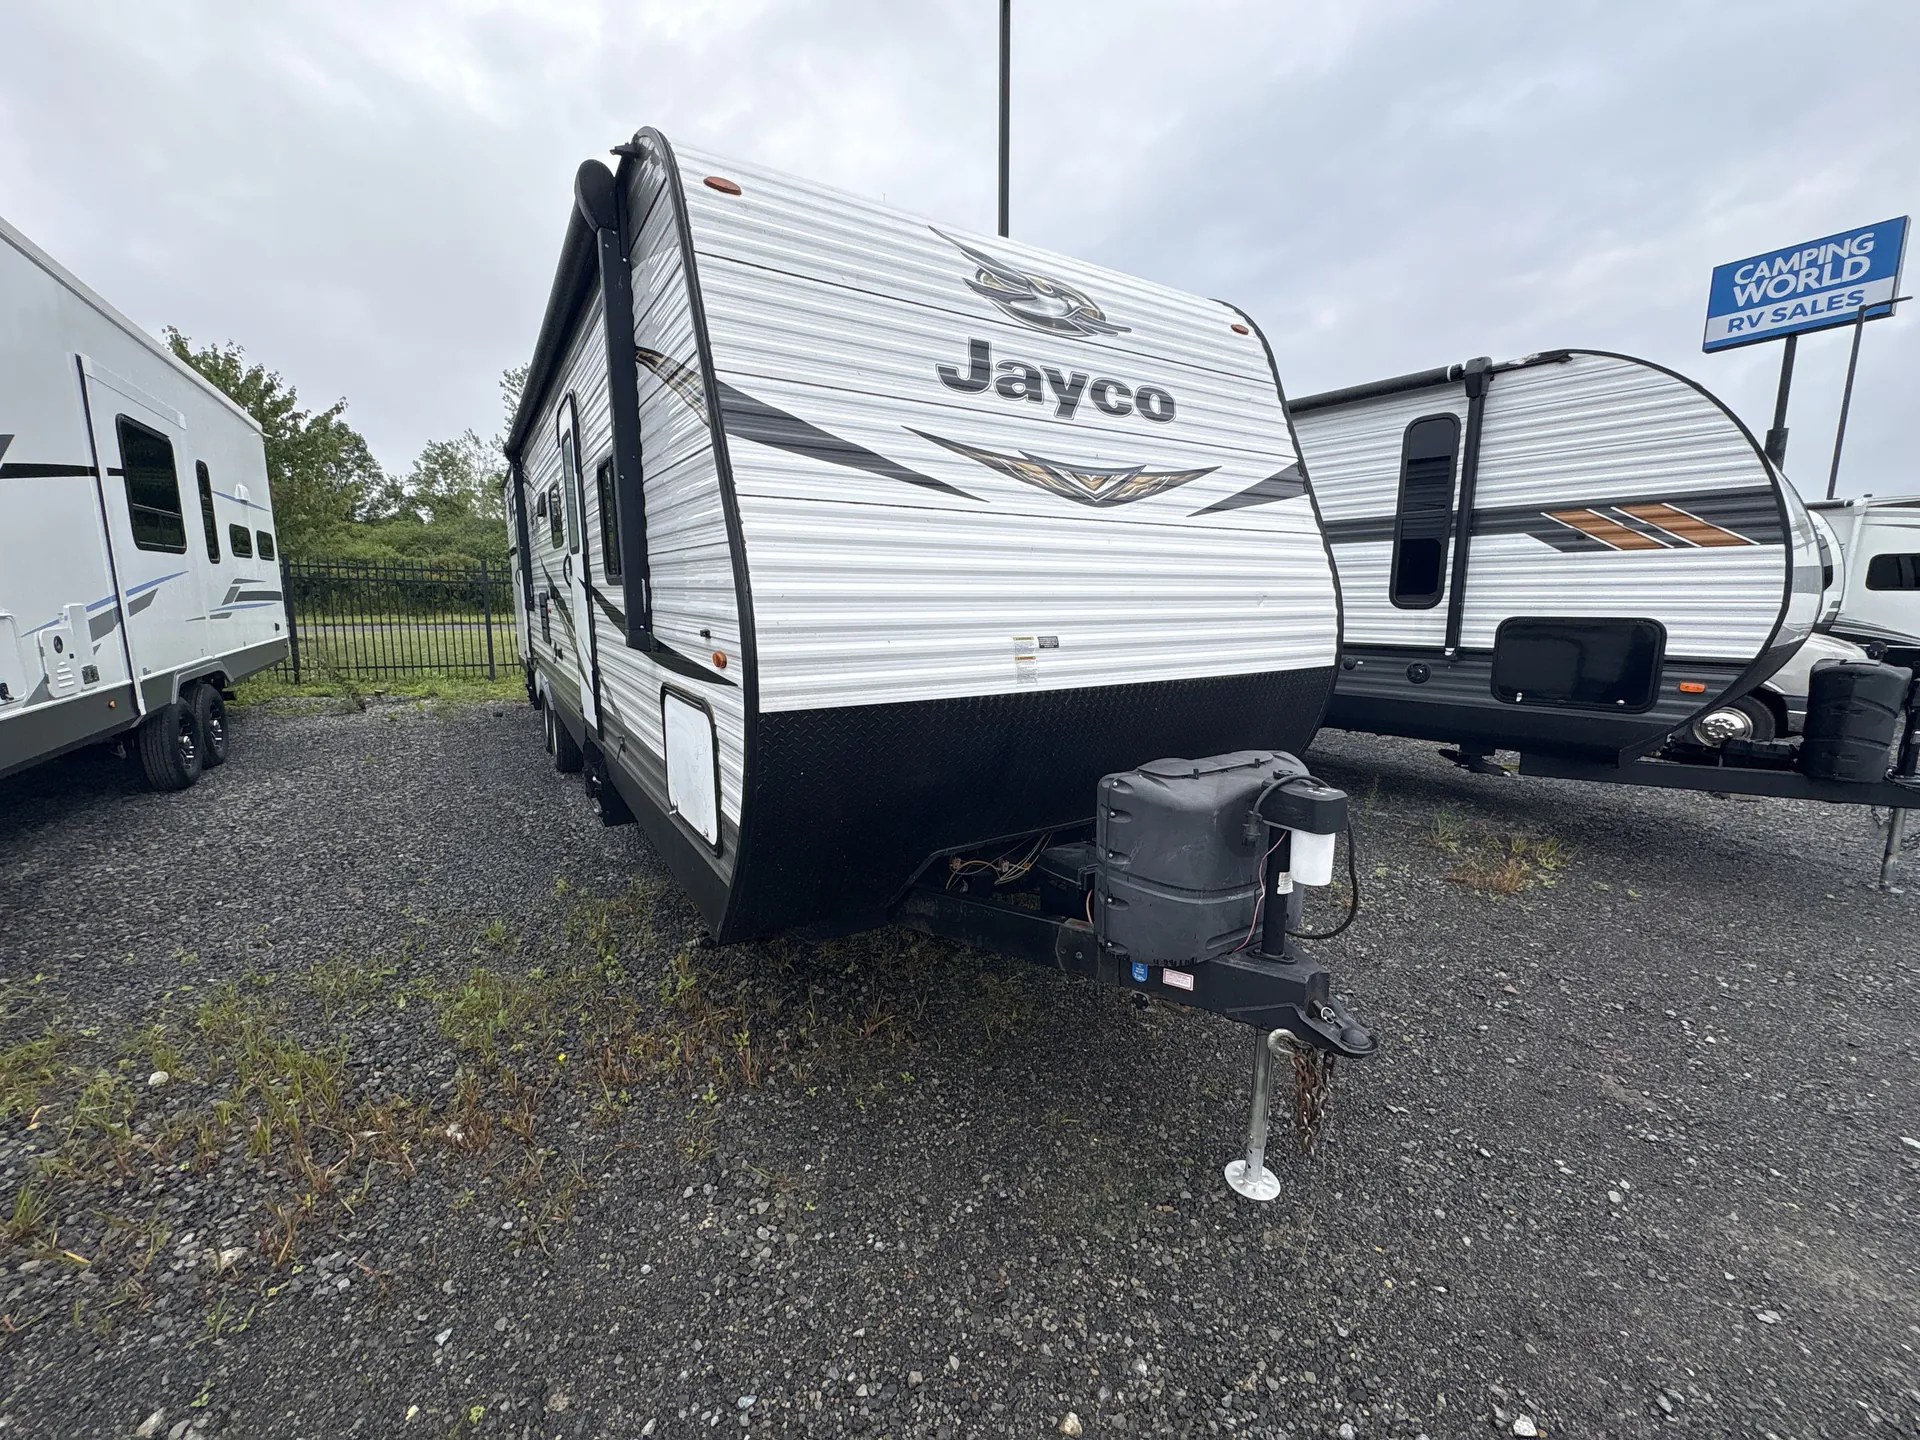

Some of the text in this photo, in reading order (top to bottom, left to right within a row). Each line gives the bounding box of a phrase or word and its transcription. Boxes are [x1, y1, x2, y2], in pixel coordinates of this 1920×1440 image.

[1733, 256, 1871, 307] WORLD
[1734, 232, 1875, 285] CAMPING
[1727, 289, 1865, 334] RV SALES
[935, 336, 1177, 424] Jayco
